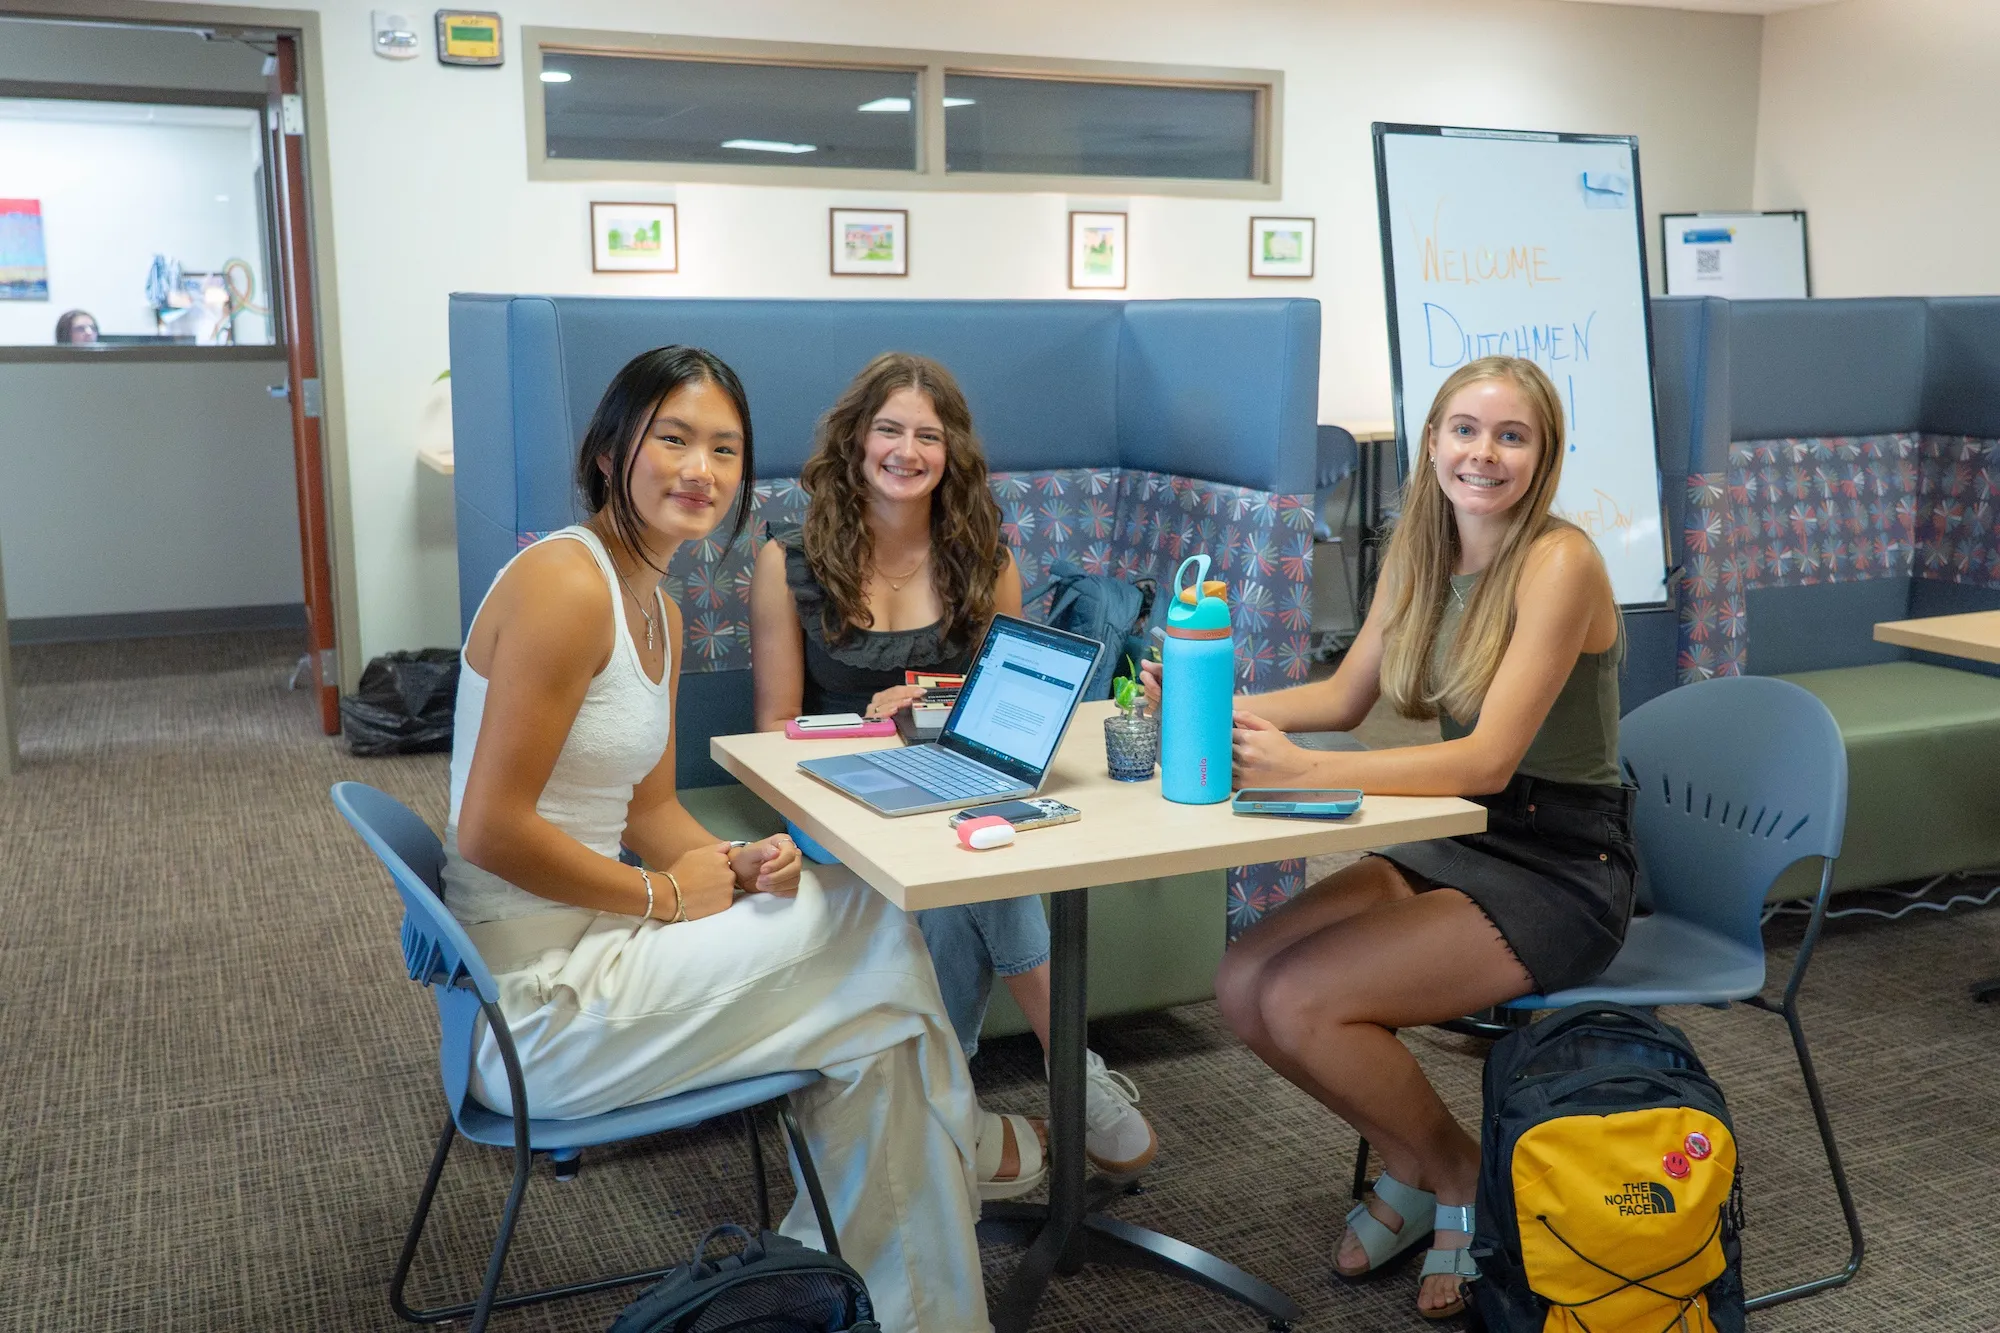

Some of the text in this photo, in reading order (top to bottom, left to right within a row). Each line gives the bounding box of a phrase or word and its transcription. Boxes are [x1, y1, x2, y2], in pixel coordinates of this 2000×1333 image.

[1404, 196, 1561, 288] WELCOME
[1423, 302, 1597, 372] DUTCHMEN
[1199, 758, 1207, 787] owala
[1623, 1182, 1649, 1193] THE
[1604, 1193, 1650, 1205] NORTH
[1619, 1204, 1652, 1216] FACE
